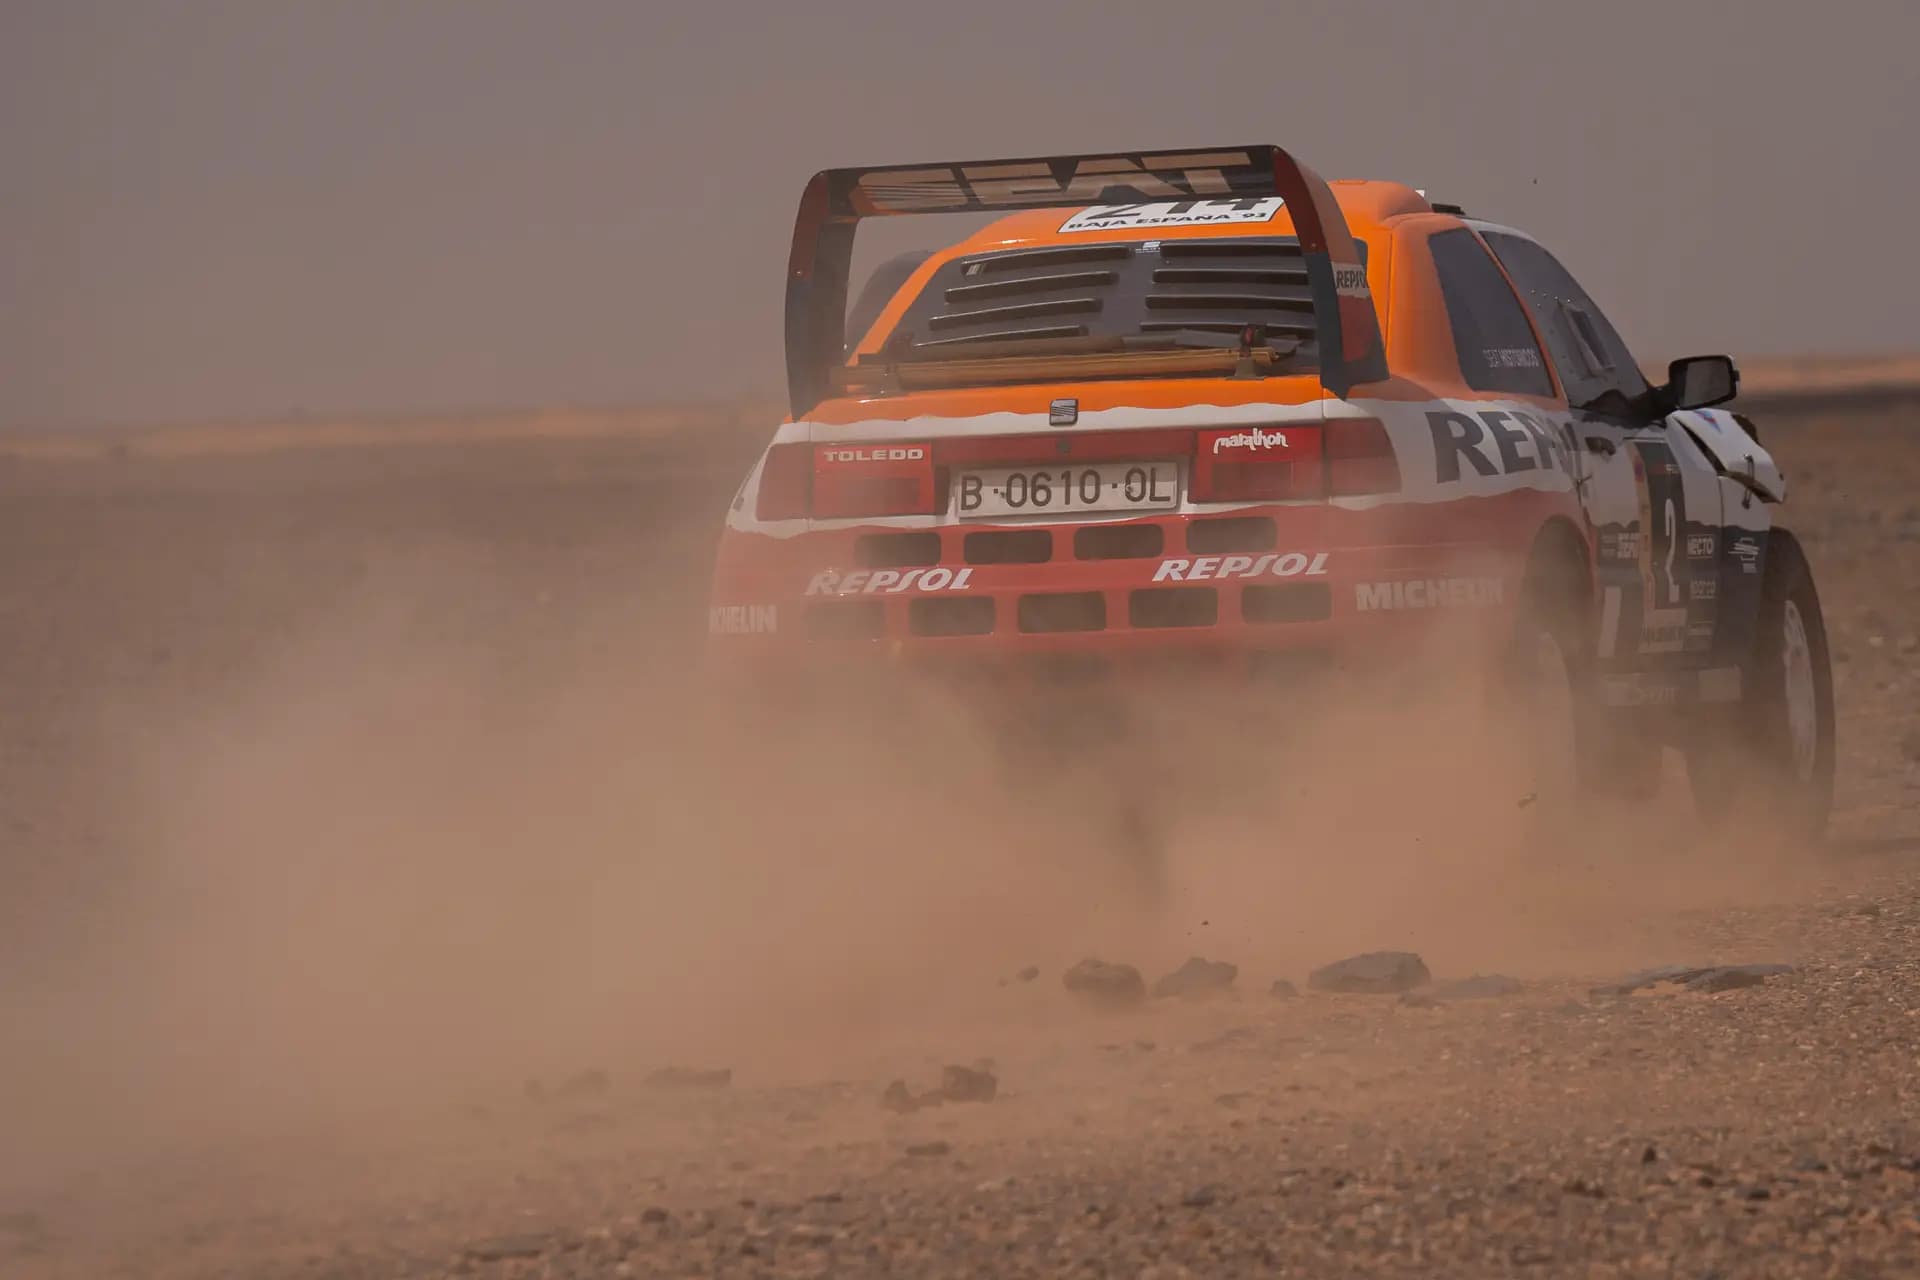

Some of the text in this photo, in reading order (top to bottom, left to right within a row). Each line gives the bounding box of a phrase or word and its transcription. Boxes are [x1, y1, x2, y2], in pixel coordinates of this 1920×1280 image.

[850, 152, 1251, 211] SEAT
[1068, 219, 1127, 230] BAJA
[823, 449, 924, 463] TOLEDO
[806, 567, 974, 596] REPSOL
[1151, 552, 1329, 583] REPSOL
[1356, 579, 1504, 610] MICHELIN
